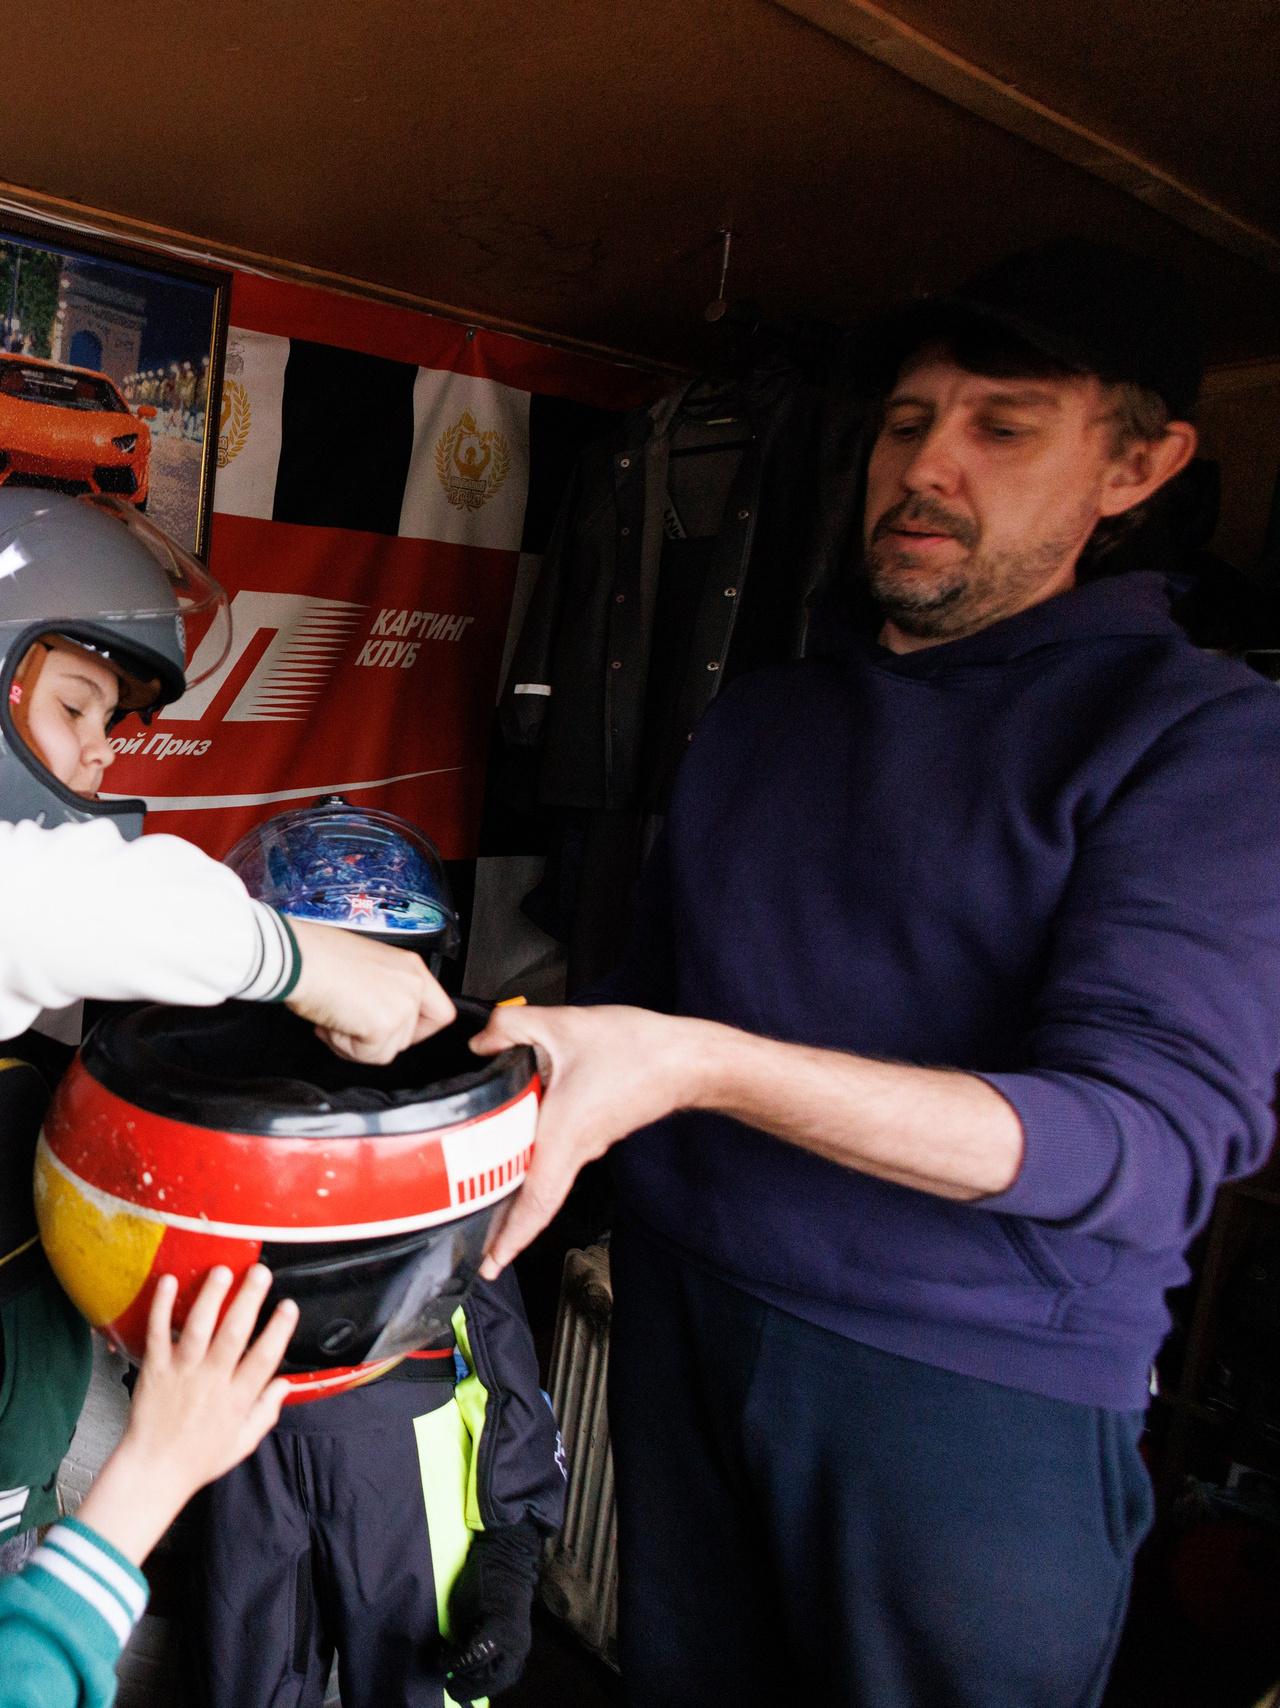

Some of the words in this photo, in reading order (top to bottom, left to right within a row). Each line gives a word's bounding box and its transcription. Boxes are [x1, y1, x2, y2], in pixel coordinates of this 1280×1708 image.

[369, 608, 475, 642] КАРТИНГ
[354, 639, 421, 669] КЛУБ
[141, 733, 213, 760] Приз
